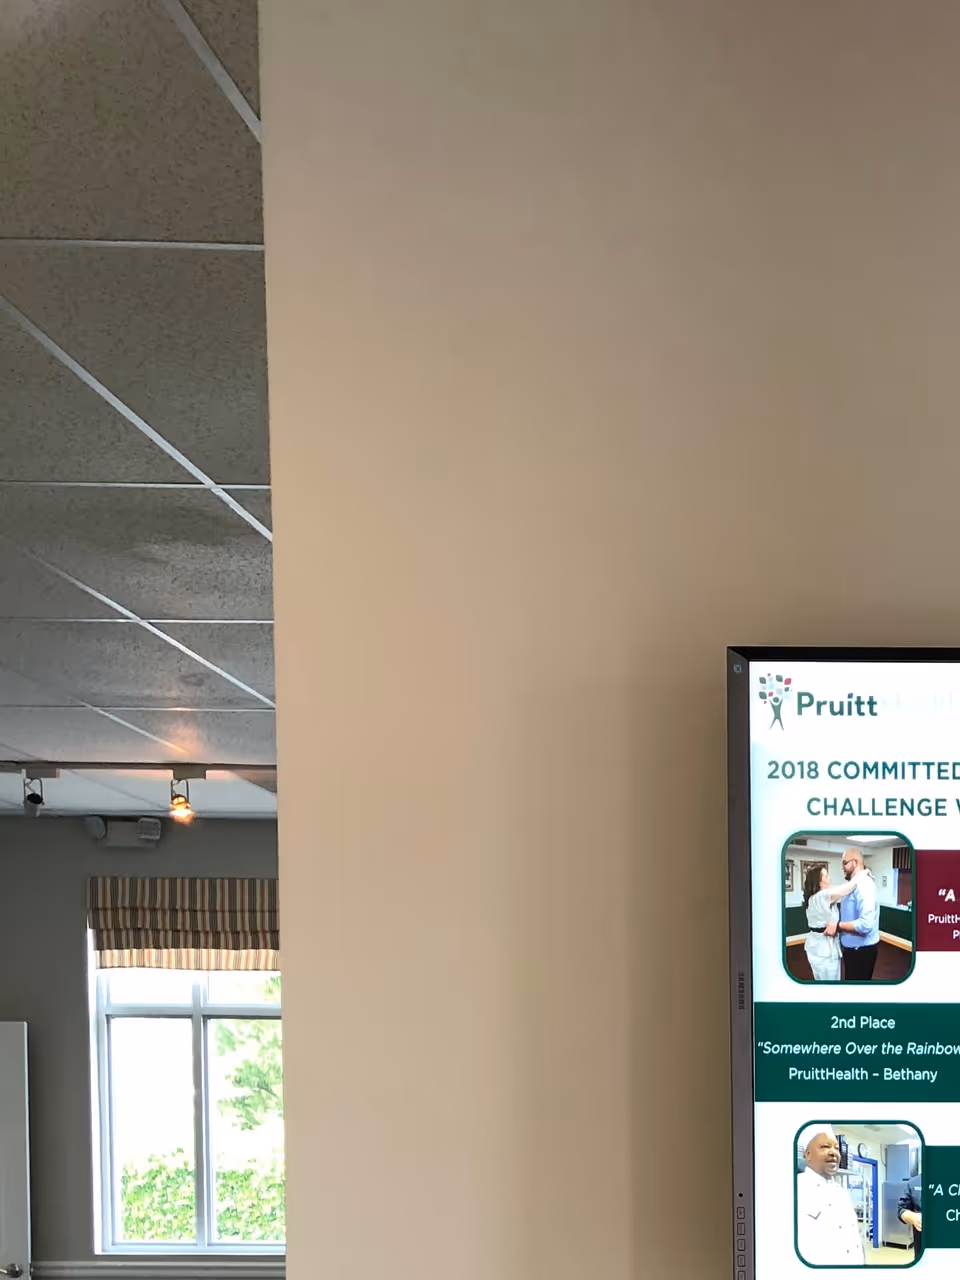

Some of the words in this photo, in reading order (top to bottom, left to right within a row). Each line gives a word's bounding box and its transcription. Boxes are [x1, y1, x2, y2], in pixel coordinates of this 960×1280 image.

[796, 692, 878, 717] Pruitt
[767, 760, 819, 780] 2018
[806, 797, 948, 817] CHALLENGE
[938, 889, 955, 902] “A
[830, 1016, 857, 1029] 2nd
[860, 1016, 896, 1029] Place
[757, 1041, 842, 1056] “Somewhere
[845, 1042, 878, 1055] Over
[881, 1042, 903, 1055] the
[788, 1067, 869, 1081] PruittHealth
[883, 1068, 938, 1083] Bethany
[928, 1183, 944, 1197] “A
